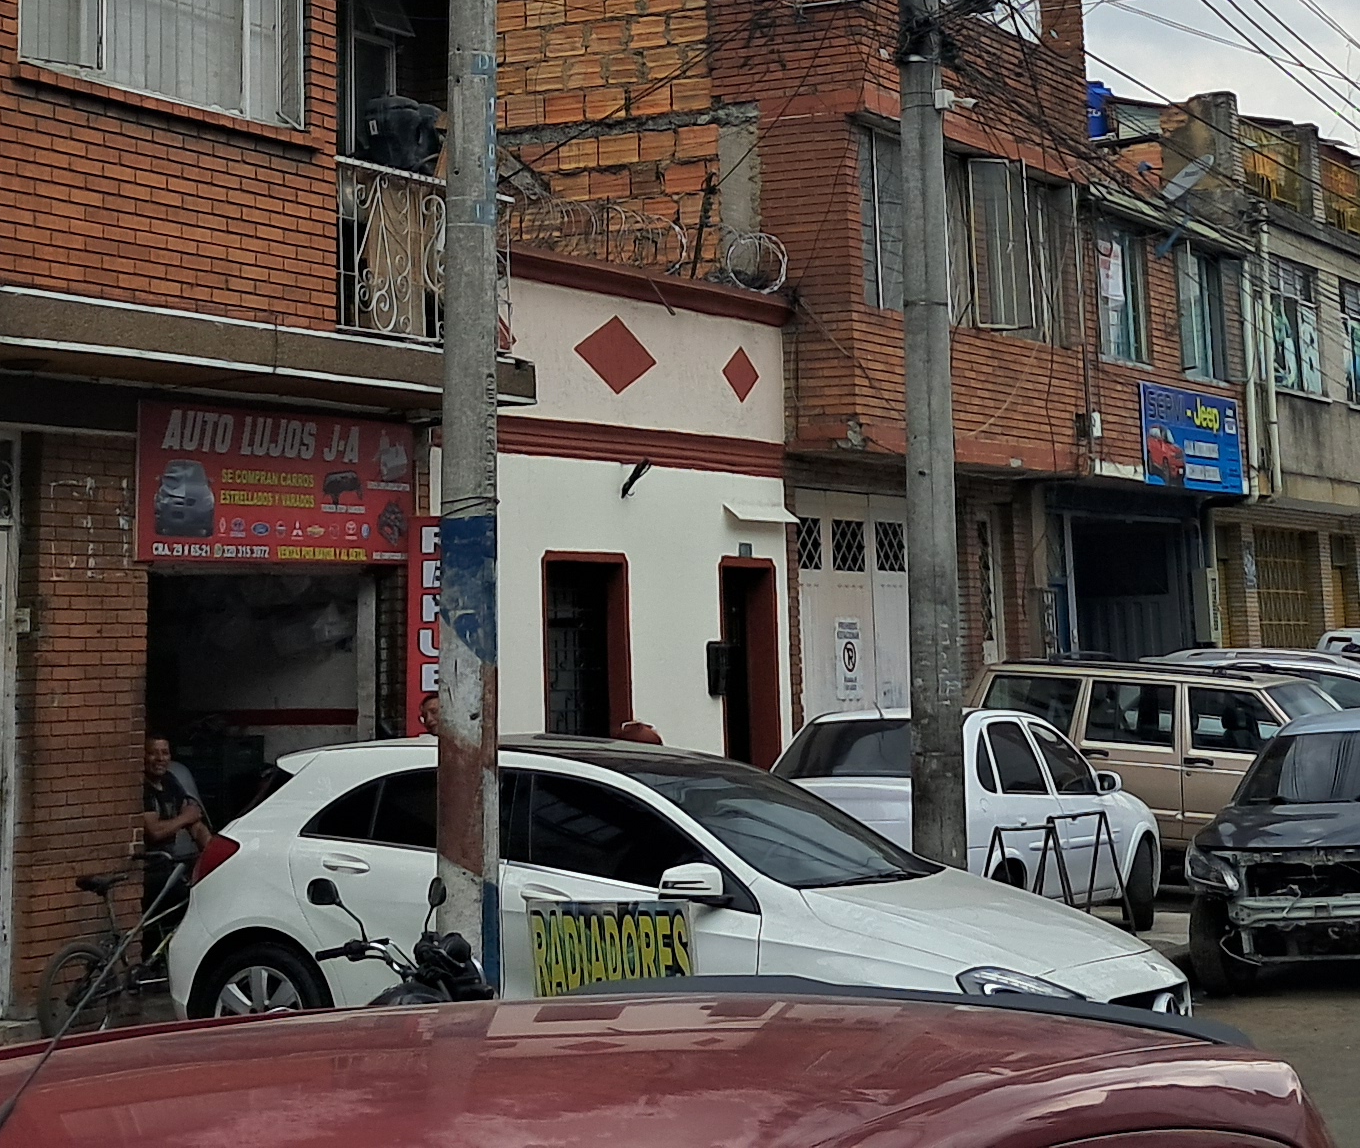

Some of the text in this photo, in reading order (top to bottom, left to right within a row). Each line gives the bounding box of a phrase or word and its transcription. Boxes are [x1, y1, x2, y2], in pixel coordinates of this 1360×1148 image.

[1193, 396, 1220, 434] Jeep
[161, 409, 360, 464] AUTO LUJOS J-A
[221, 468, 315, 488] SE COMPRAN CARROS
[220, 489, 273, 506] ESTRELLADOS
[282, 494, 315, 508] VARADOS
[528, 909, 693, 998] RADIADORES
